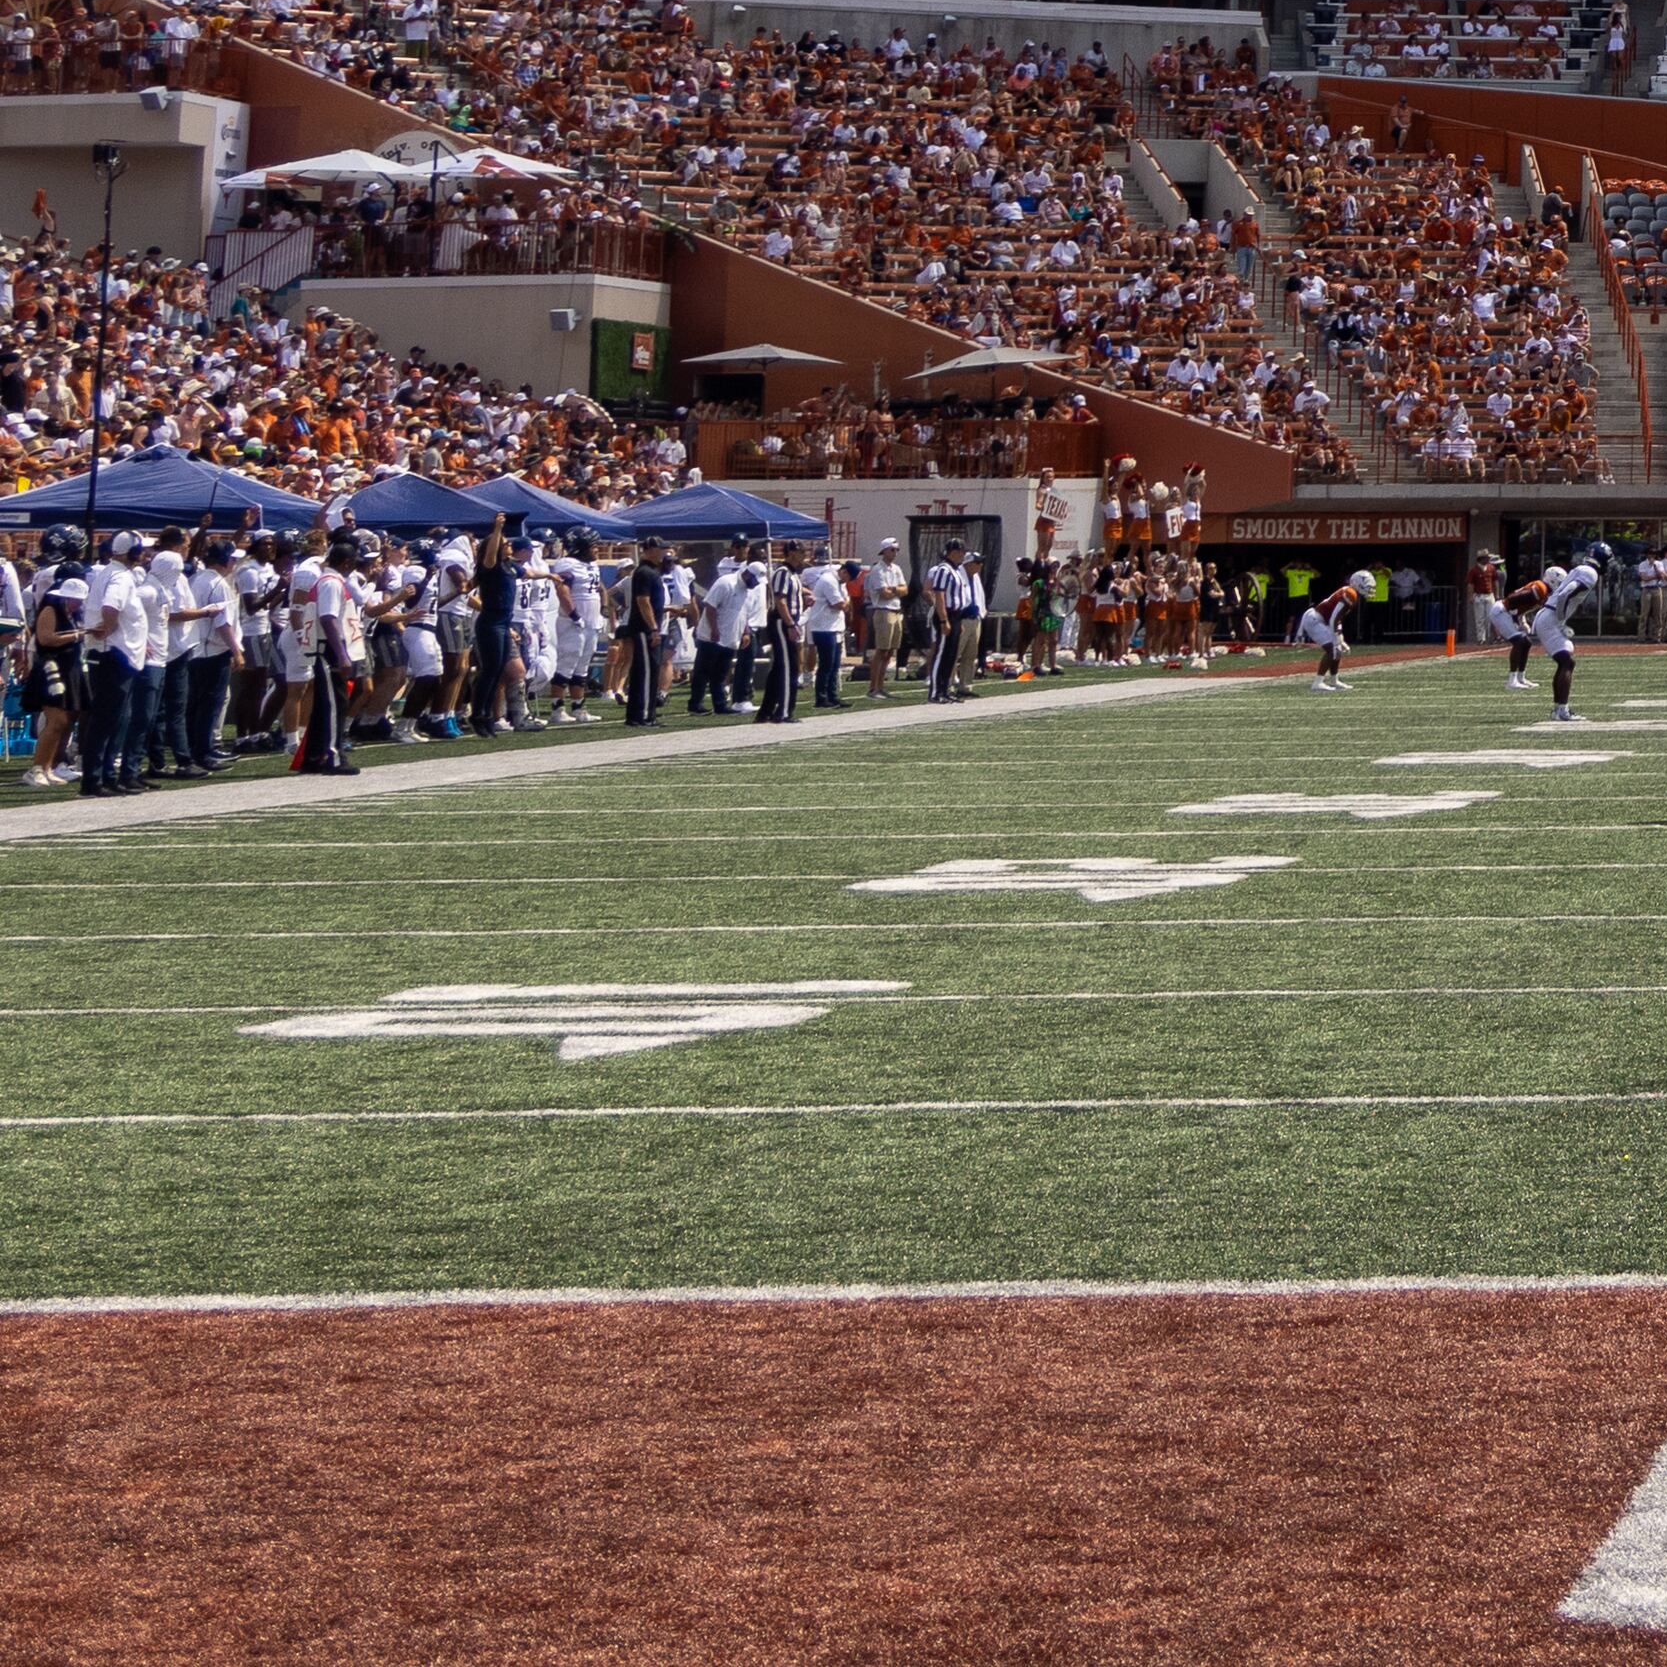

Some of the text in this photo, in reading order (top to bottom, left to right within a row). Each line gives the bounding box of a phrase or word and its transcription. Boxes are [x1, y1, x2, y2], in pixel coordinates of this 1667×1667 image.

[1232, 517, 1462, 540] SMOKEY THE CANNON
